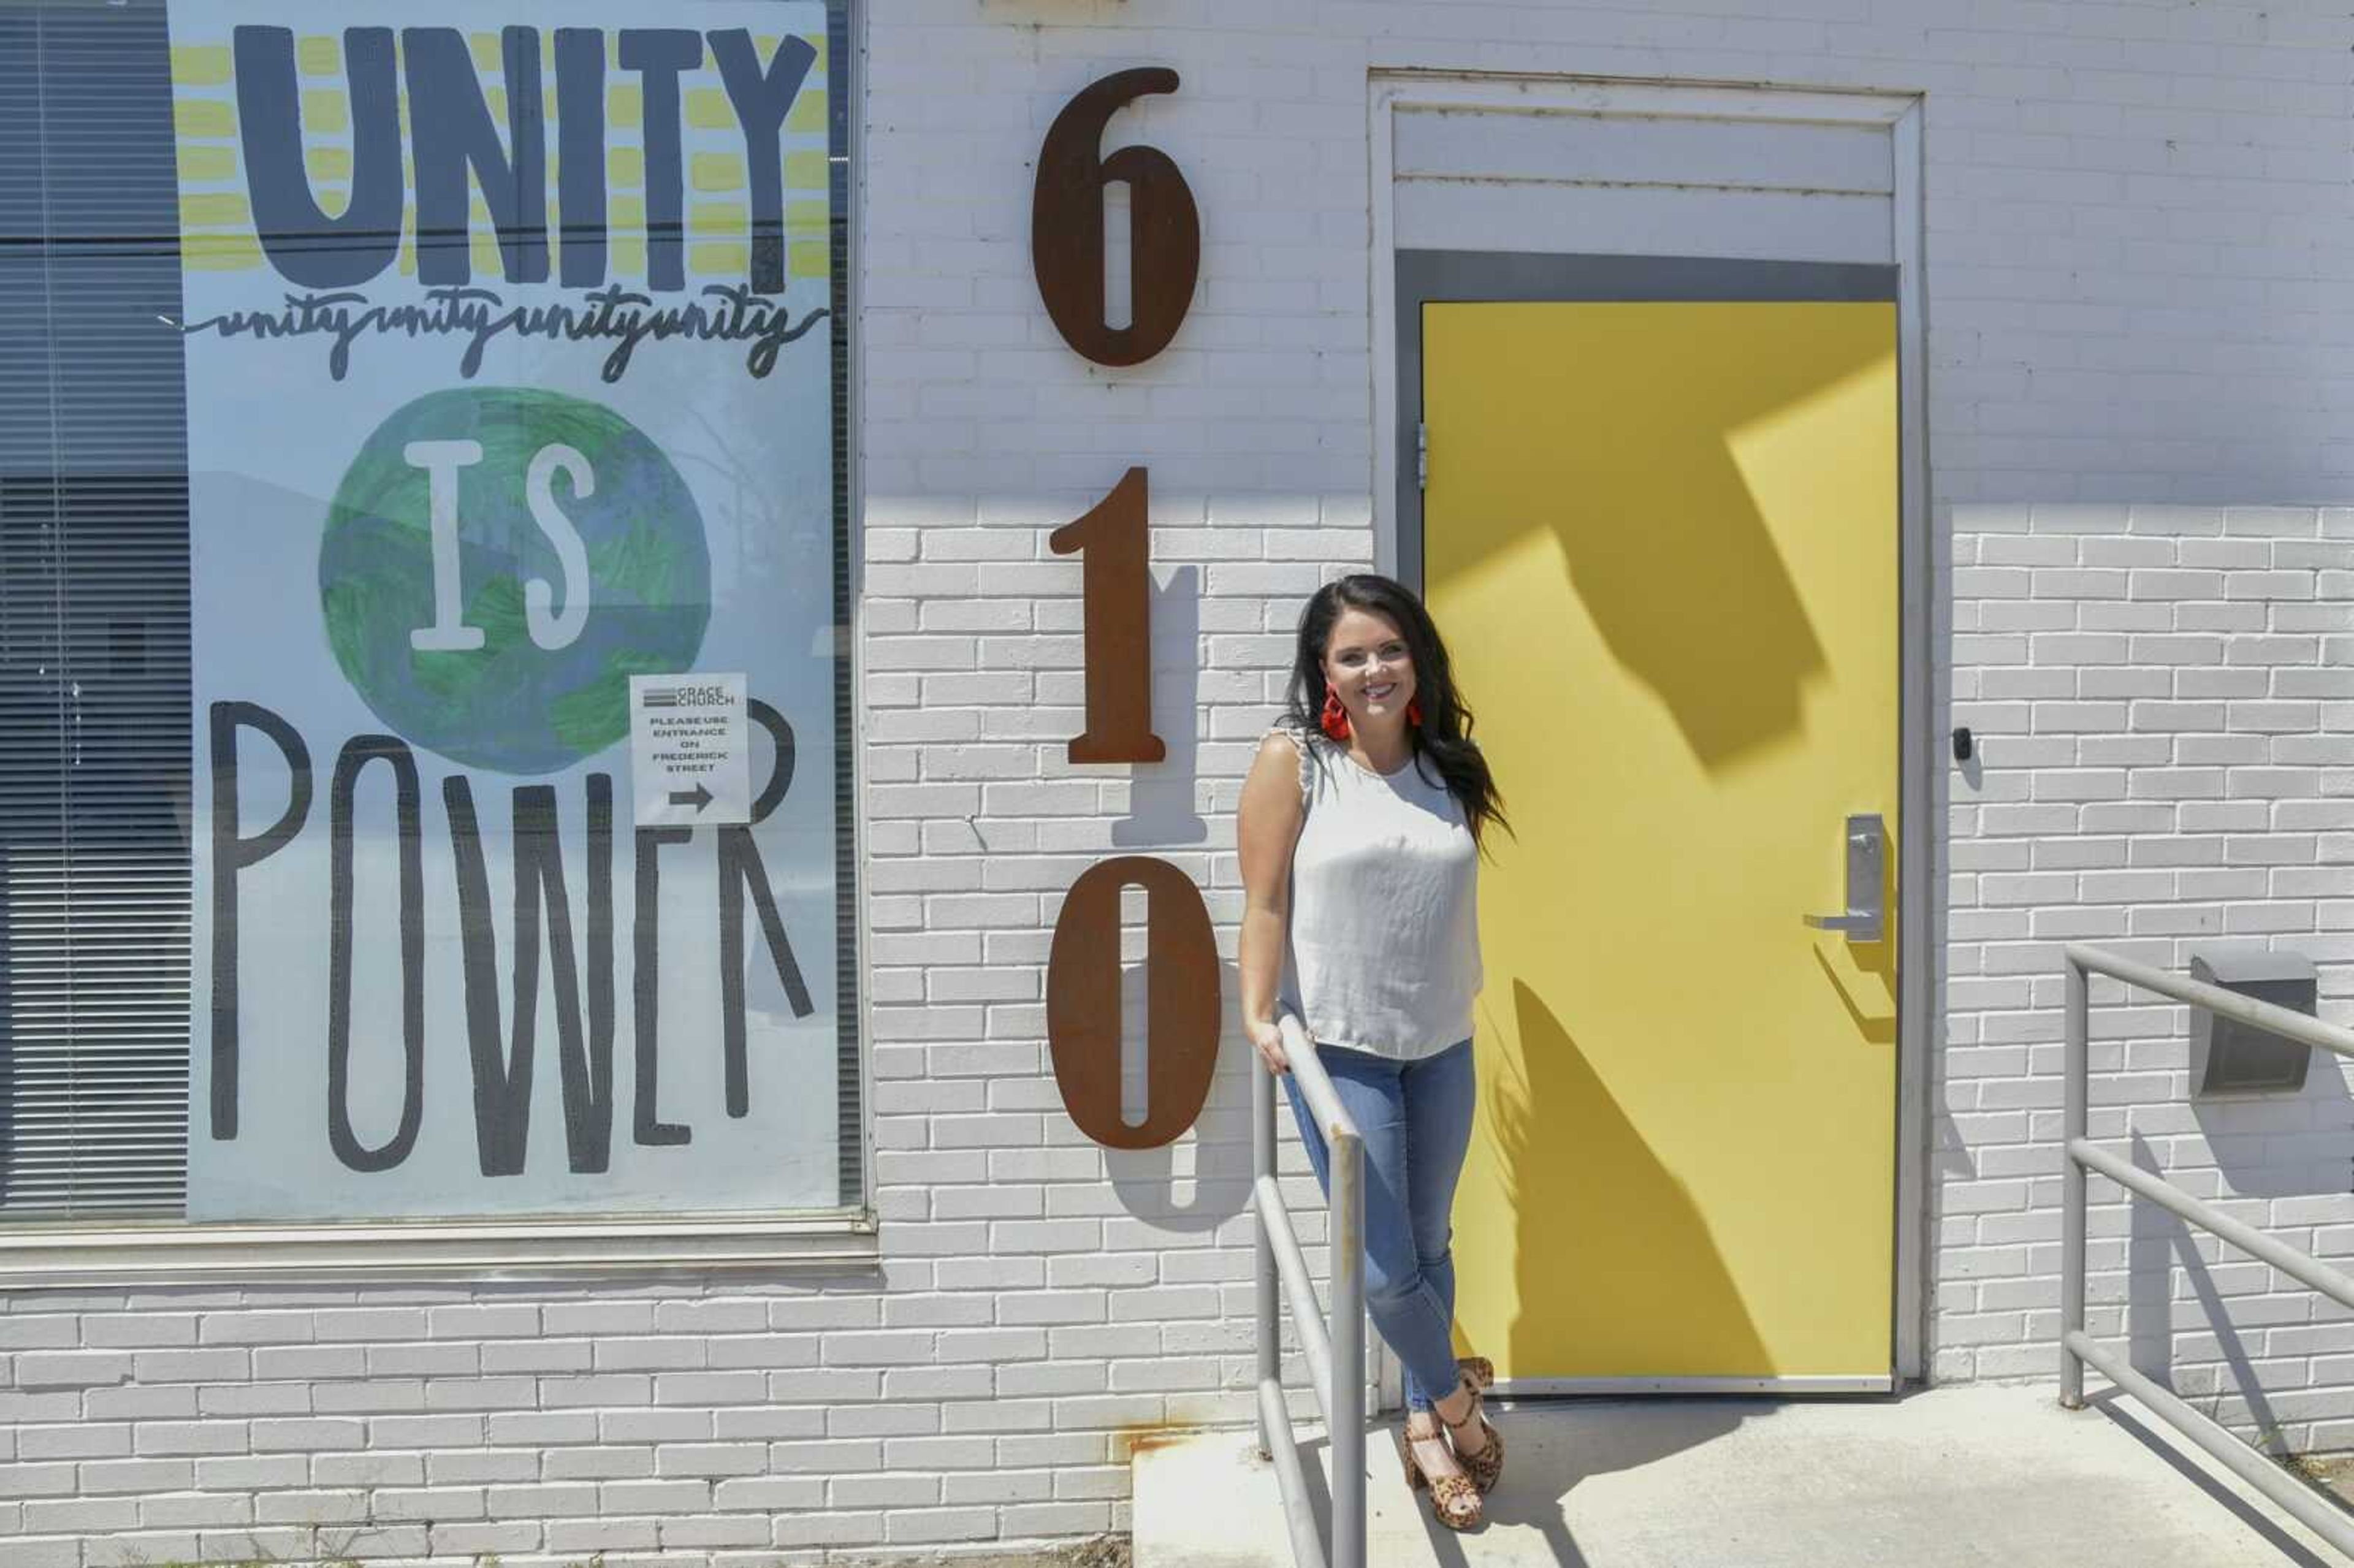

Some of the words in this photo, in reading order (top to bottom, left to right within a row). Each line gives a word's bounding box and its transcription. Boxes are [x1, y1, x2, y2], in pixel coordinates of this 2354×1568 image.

[234, 25, 817, 293] UNITY
[403, 440, 595, 650] IS
[677, 687, 724, 697] GRACE
[677, 695, 734, 706] CHURCH
[653, 728, 727, 737] ENTRANCE
[652, 752, 729, 761] FREDERICK
[210, 698, 814, 1176] POWER
